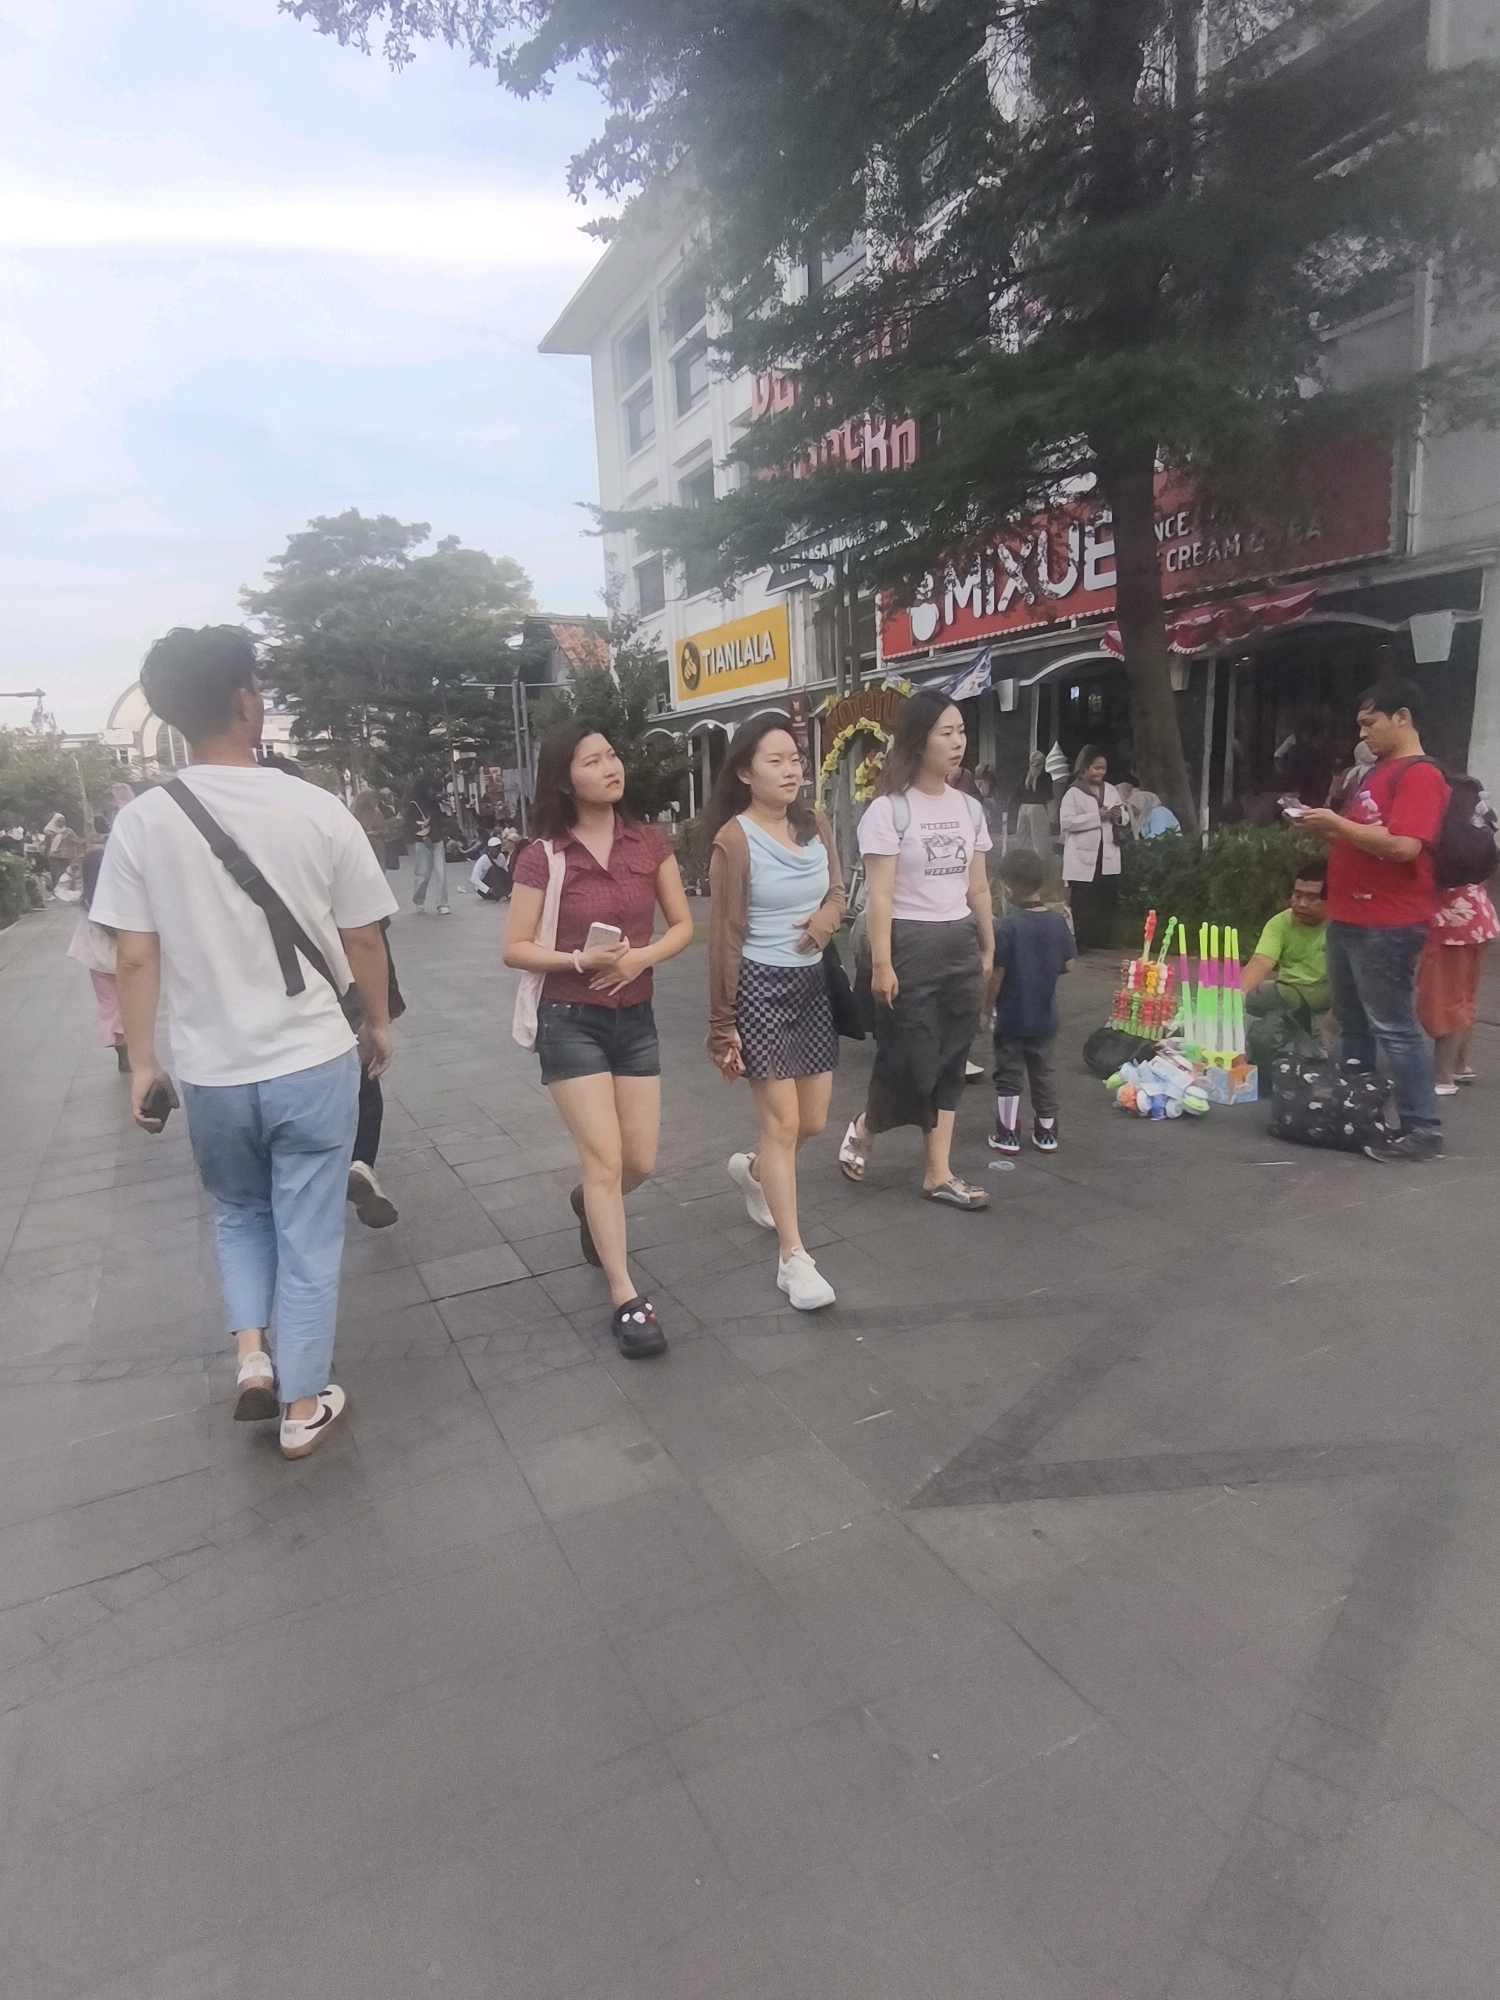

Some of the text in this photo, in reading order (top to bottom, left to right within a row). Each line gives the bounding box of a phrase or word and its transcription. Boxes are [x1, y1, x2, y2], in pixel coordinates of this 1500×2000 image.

[944, 509, 1117, 626] MIXUE
[1166, 532, 1241, 572] CREAM
[702, 631, 775, 676] TIANLALA
